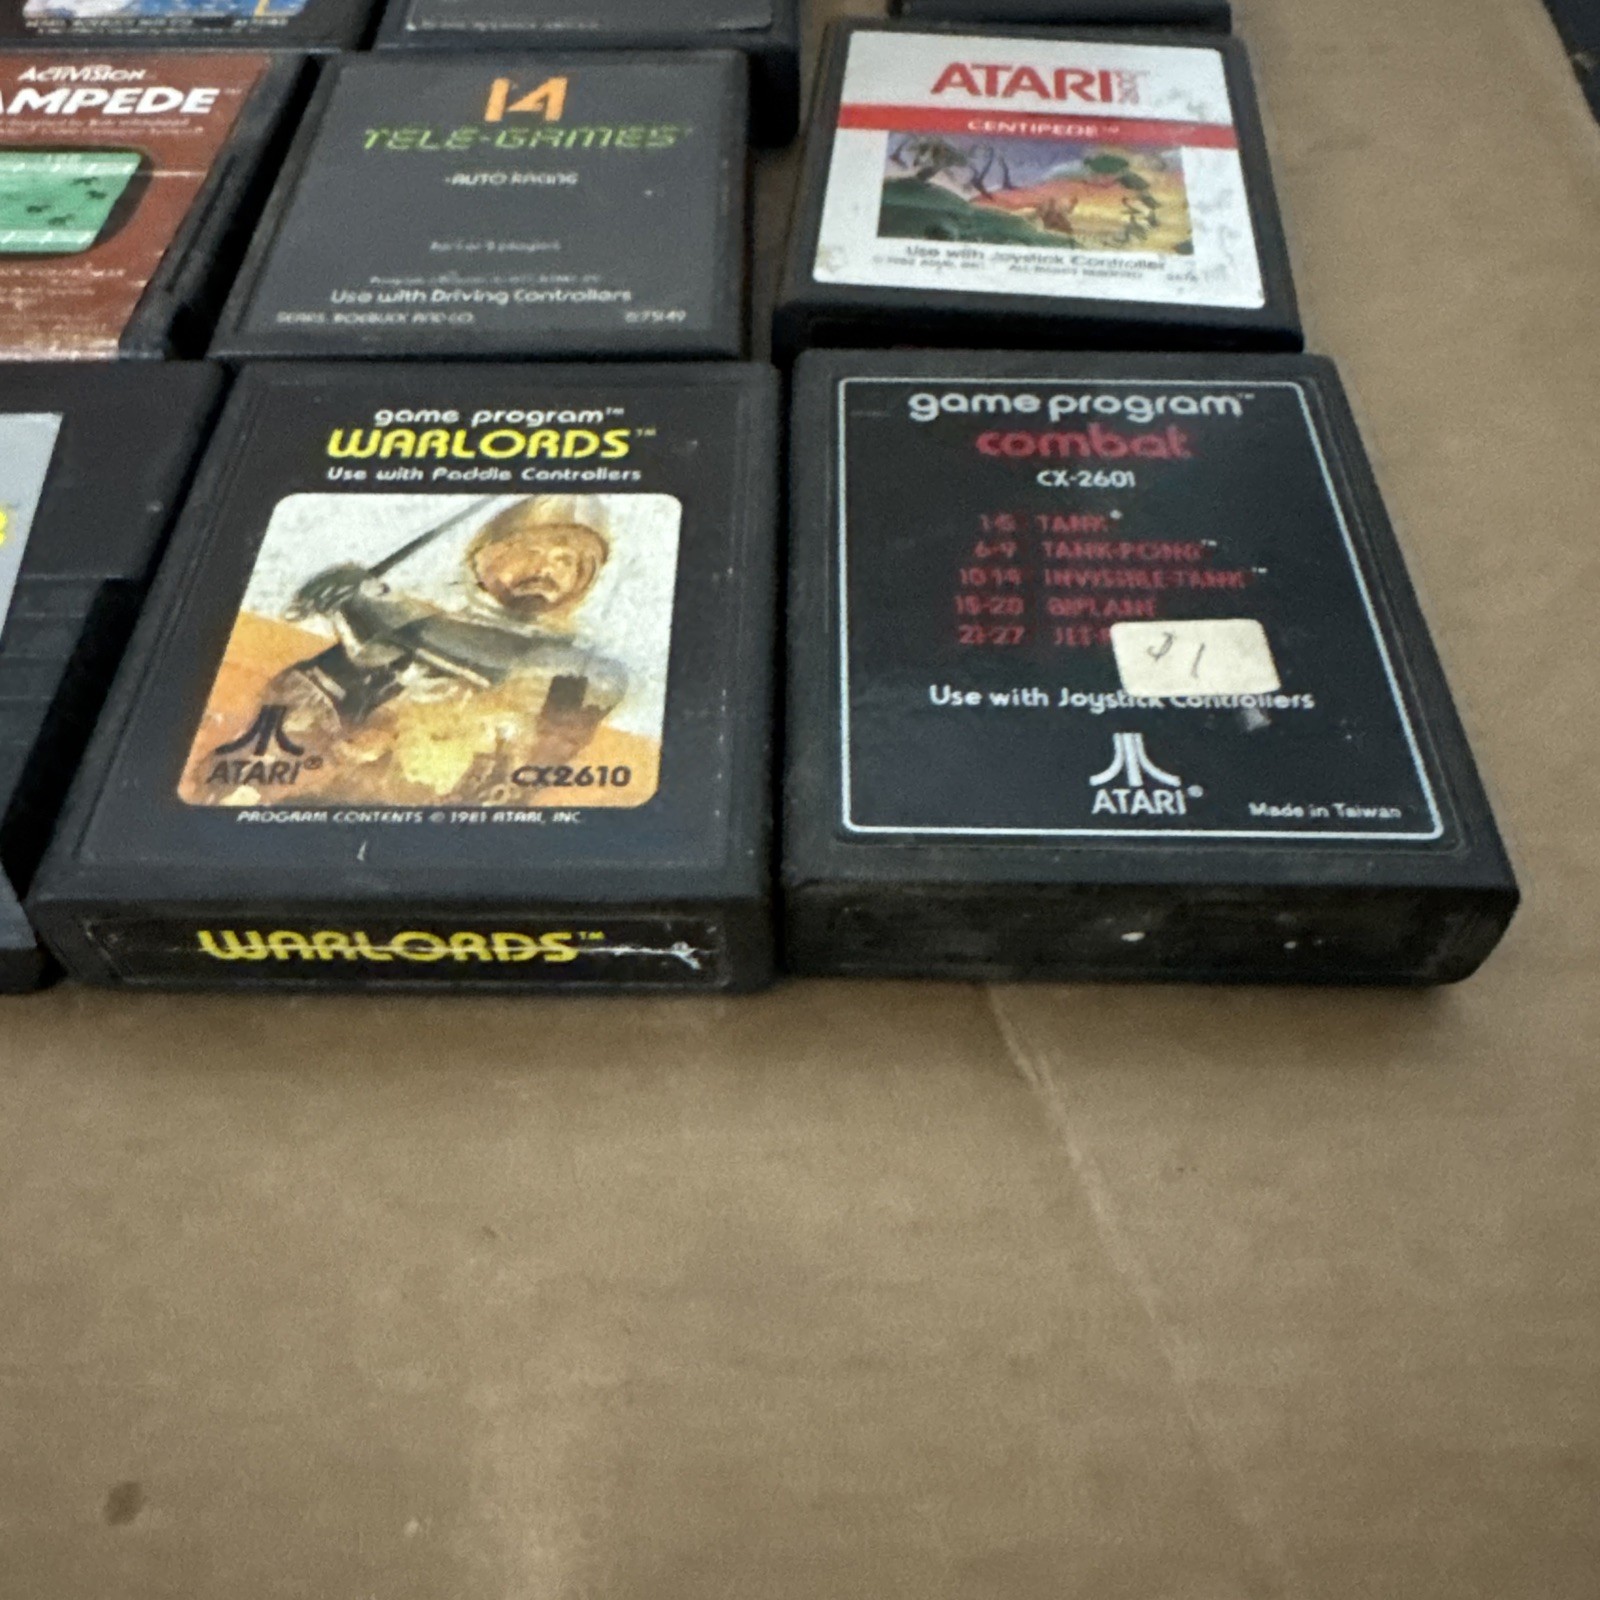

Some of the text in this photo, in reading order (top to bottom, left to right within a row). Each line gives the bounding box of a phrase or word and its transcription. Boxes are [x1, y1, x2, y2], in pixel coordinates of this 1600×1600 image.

[18, 64, 147, 82] ACTIVISION
[930, 62, 1113, 103] ATARI
[330, 287, 631, 306] Use with Driving Controllers
[908, 392, 1042, 422] game
[374, 408, 460, 427] game
[975, 421, 1192, 459] combat
[327, 467, 642, 482] Use with Paddle Controllers
[1036, 470, 1137, 488] CX-2601
[928, 685, 983, 706] Use
[988, 686, 1050, 707] with
[1057, 686, 1165, 714] Joystick
[510, 764, 632, 788] CX2610
[236, 810, 328, 824] PROGRAM
[332, 810, 423, 824] CONTENTS
[449, 811, 488, 824] 1981
[1248, 801, 1402, 818] Made in Taiwan
